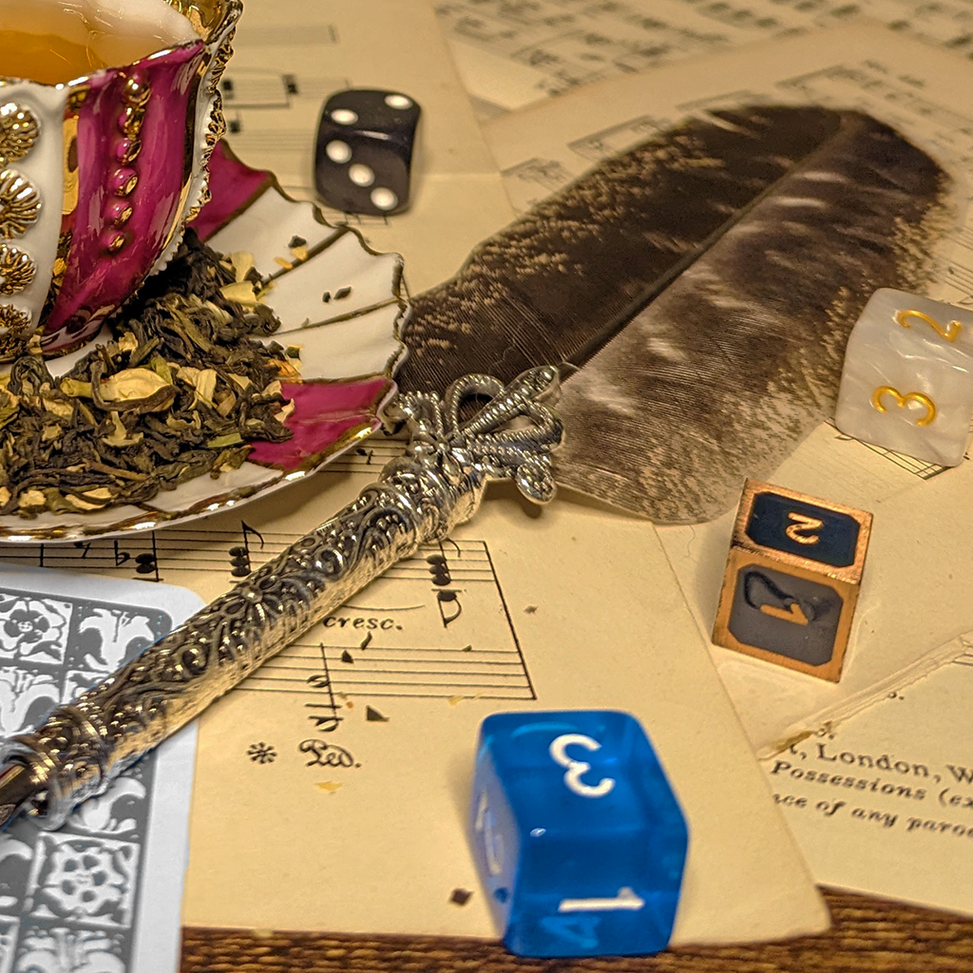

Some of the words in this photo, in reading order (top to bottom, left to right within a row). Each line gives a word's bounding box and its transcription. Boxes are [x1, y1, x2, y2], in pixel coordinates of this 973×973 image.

[894, 309, 964, 342] 2
[871, 384, 937, 427] 3
[785, 511, 824, 545] 2
[323, 615, 403, 631] cresc.
[549, 733, 616, 798] 3
[816, 742, 941, 784] London,
[770, 760, 927, 801] Possessions
[816, 800, 847, 816] of
[851, 806, 899, 828] any
[558, 885, 645, 913] 1
